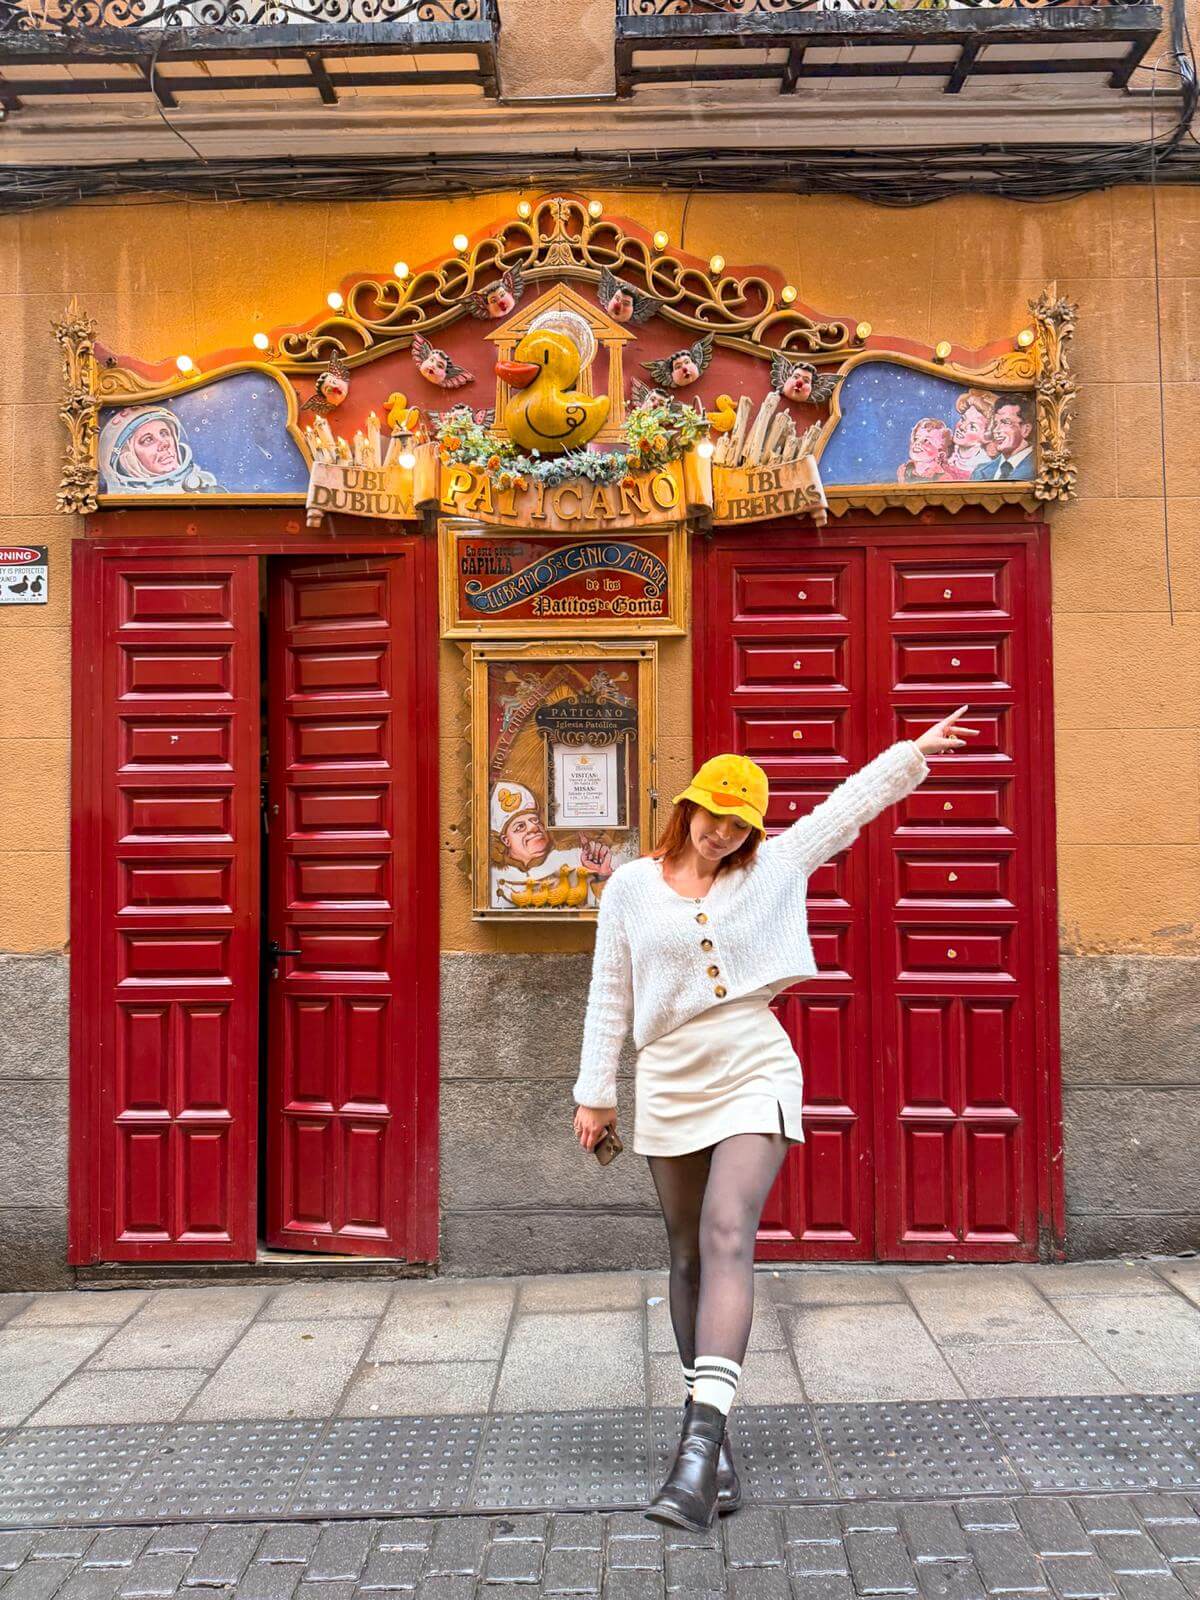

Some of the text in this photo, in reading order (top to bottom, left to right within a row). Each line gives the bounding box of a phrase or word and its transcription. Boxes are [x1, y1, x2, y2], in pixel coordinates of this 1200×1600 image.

[342, 468, 386, 492] UBI
[746, 468, 783, 494] IBI
[311, 484, 419, 515] DUBIUM
[441, 467, 680, 521] PATICANO
[712, 484, 822, 520] LIBERTAS
[461, 556, 512, 575] CAPILLA
[473, 557, 557, 610] CELEBRAMOS
[565, 546, 621, 570] GENIO
[618, 550, 667, 591] AMABLE
[585, 578, 621, 591] de los
[533, 595, 664, 616] Patitos de Goma
[551, 708, 623, 718] PATICANO
[556, 720, 584, 729] Iglesia
[492, 689, 544, 770] HOLY CHURCH
